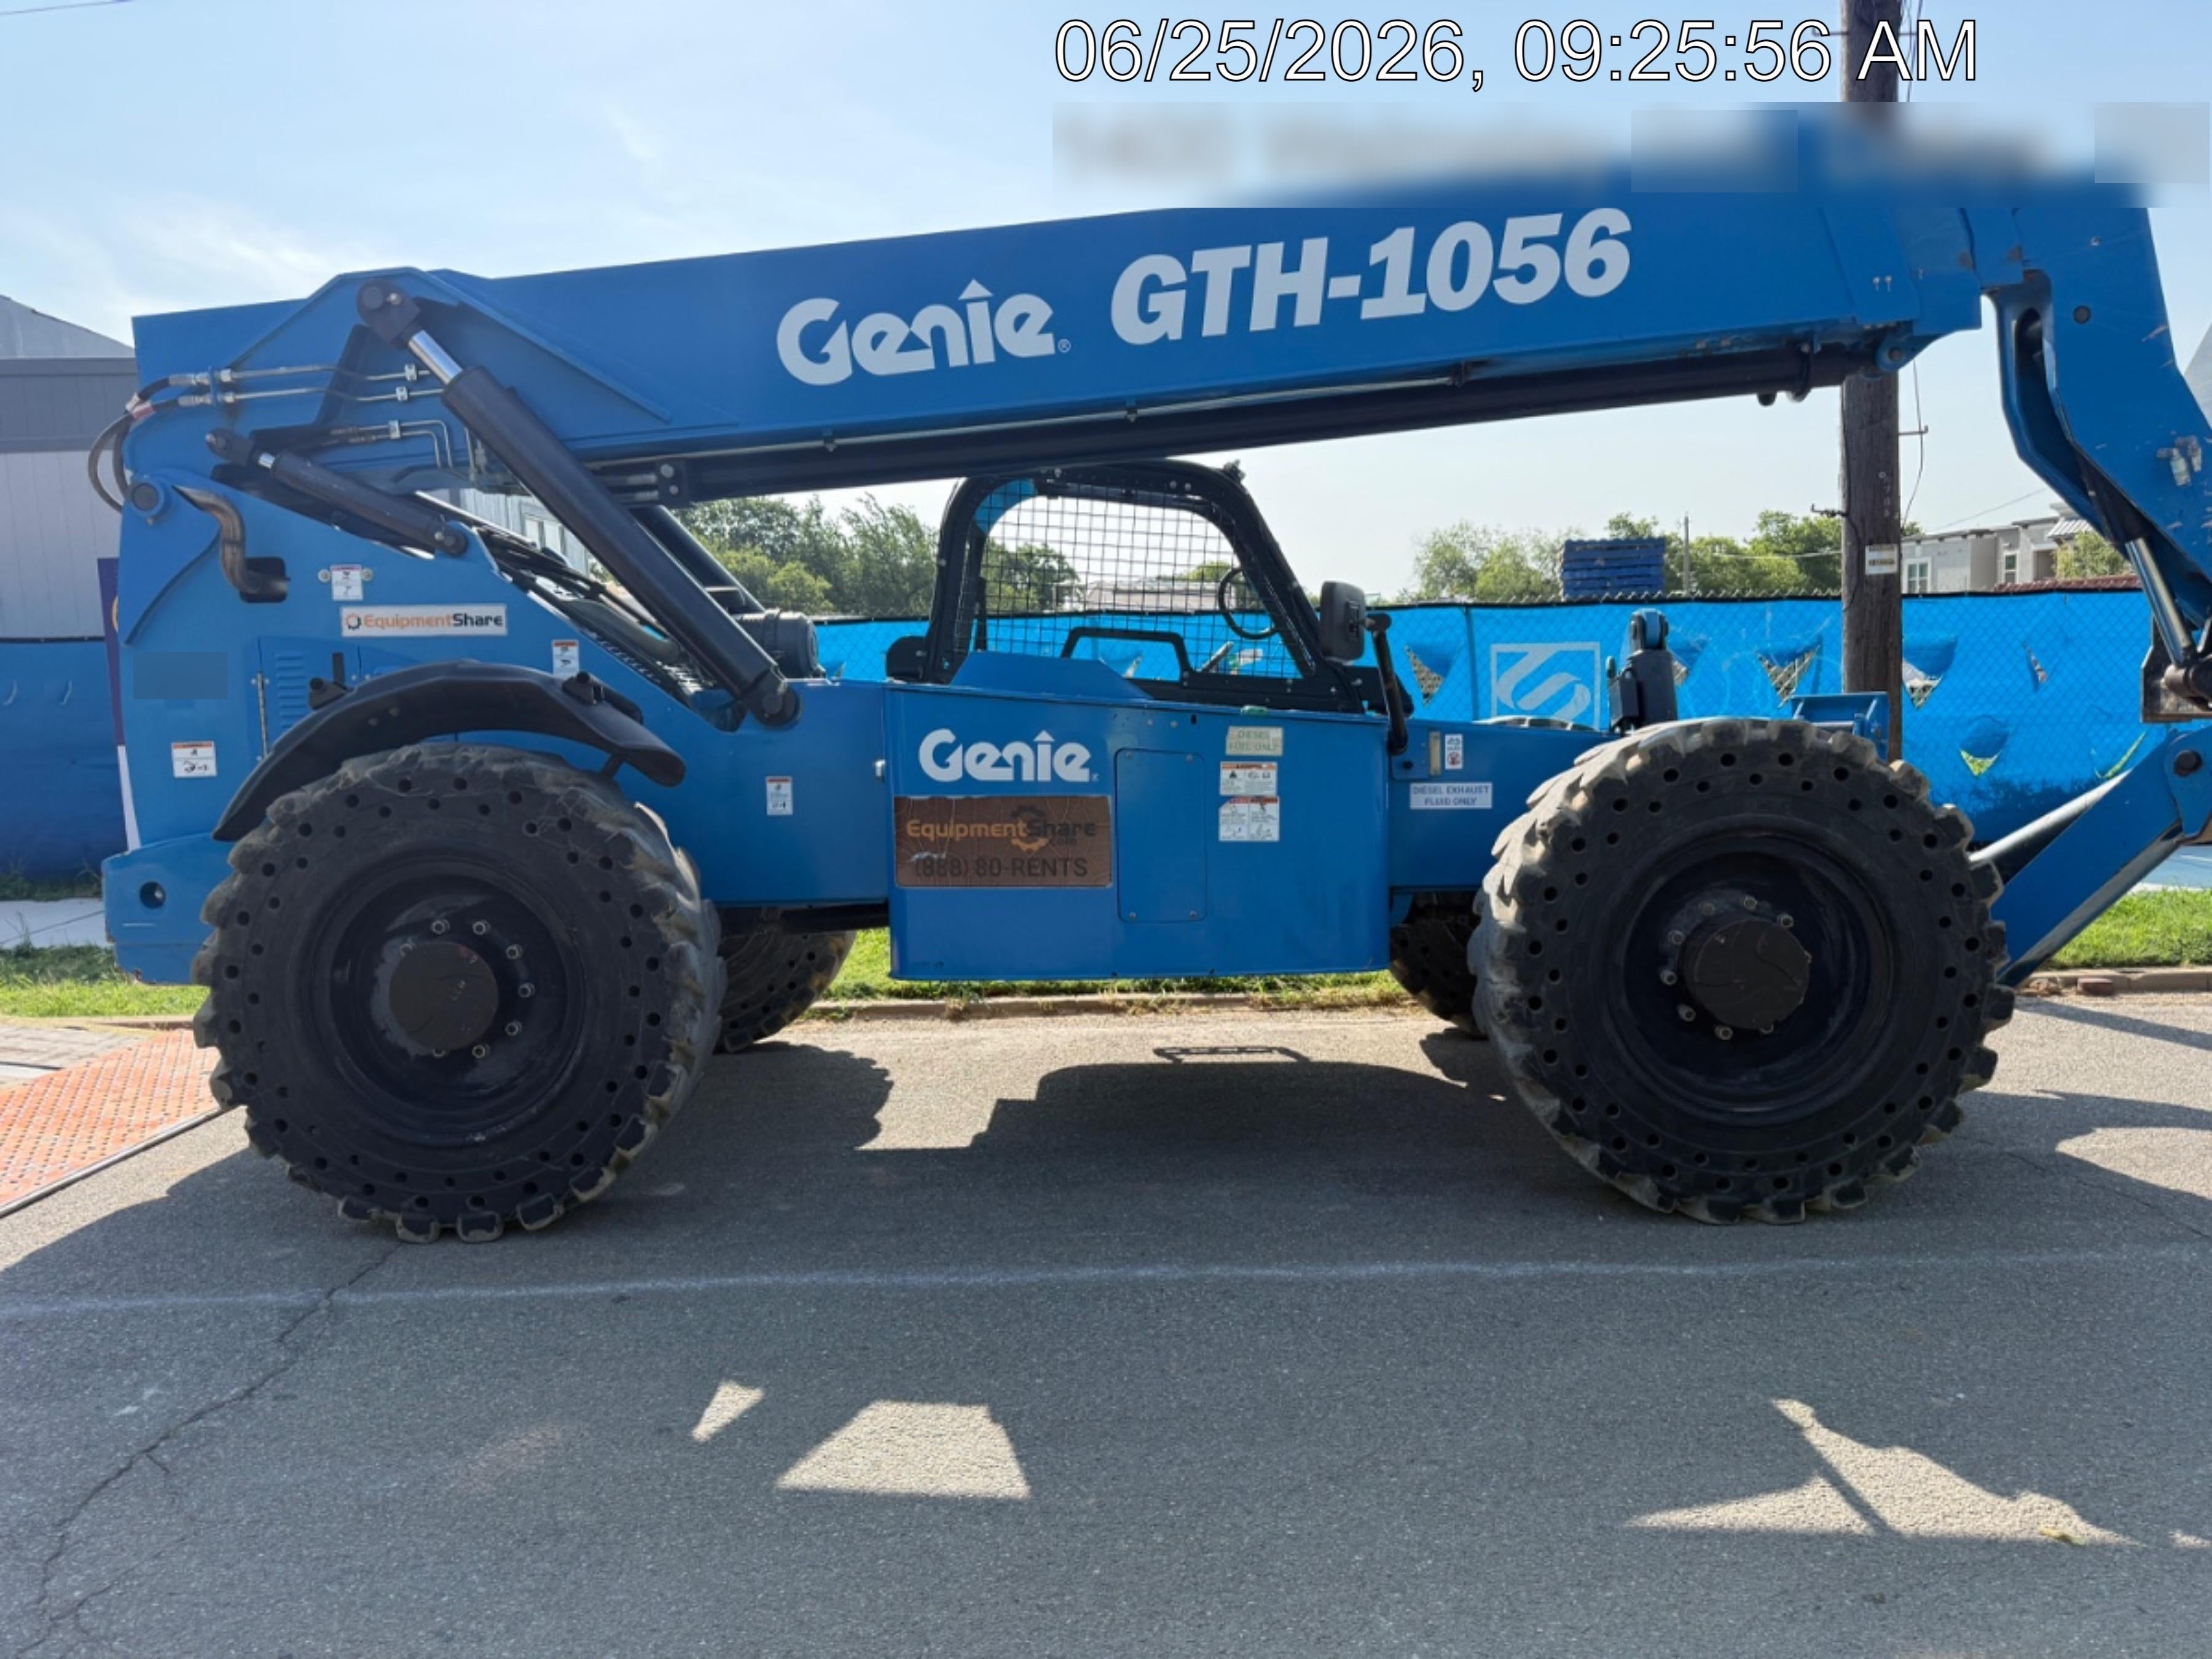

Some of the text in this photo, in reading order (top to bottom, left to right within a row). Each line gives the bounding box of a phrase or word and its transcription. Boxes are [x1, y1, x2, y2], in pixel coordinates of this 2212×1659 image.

[777, 208, 1632, 386] Genie GTH-1056
[364, 613, 503, 629] EquipmentShare
[919, 728, 1091, 782] Genie
[1446, 785, 1489, 794] EXHAUST
[1453, 797, 1477, 806] ONLY
[916, 857, 1088, 877] (888) 80-RENTS
